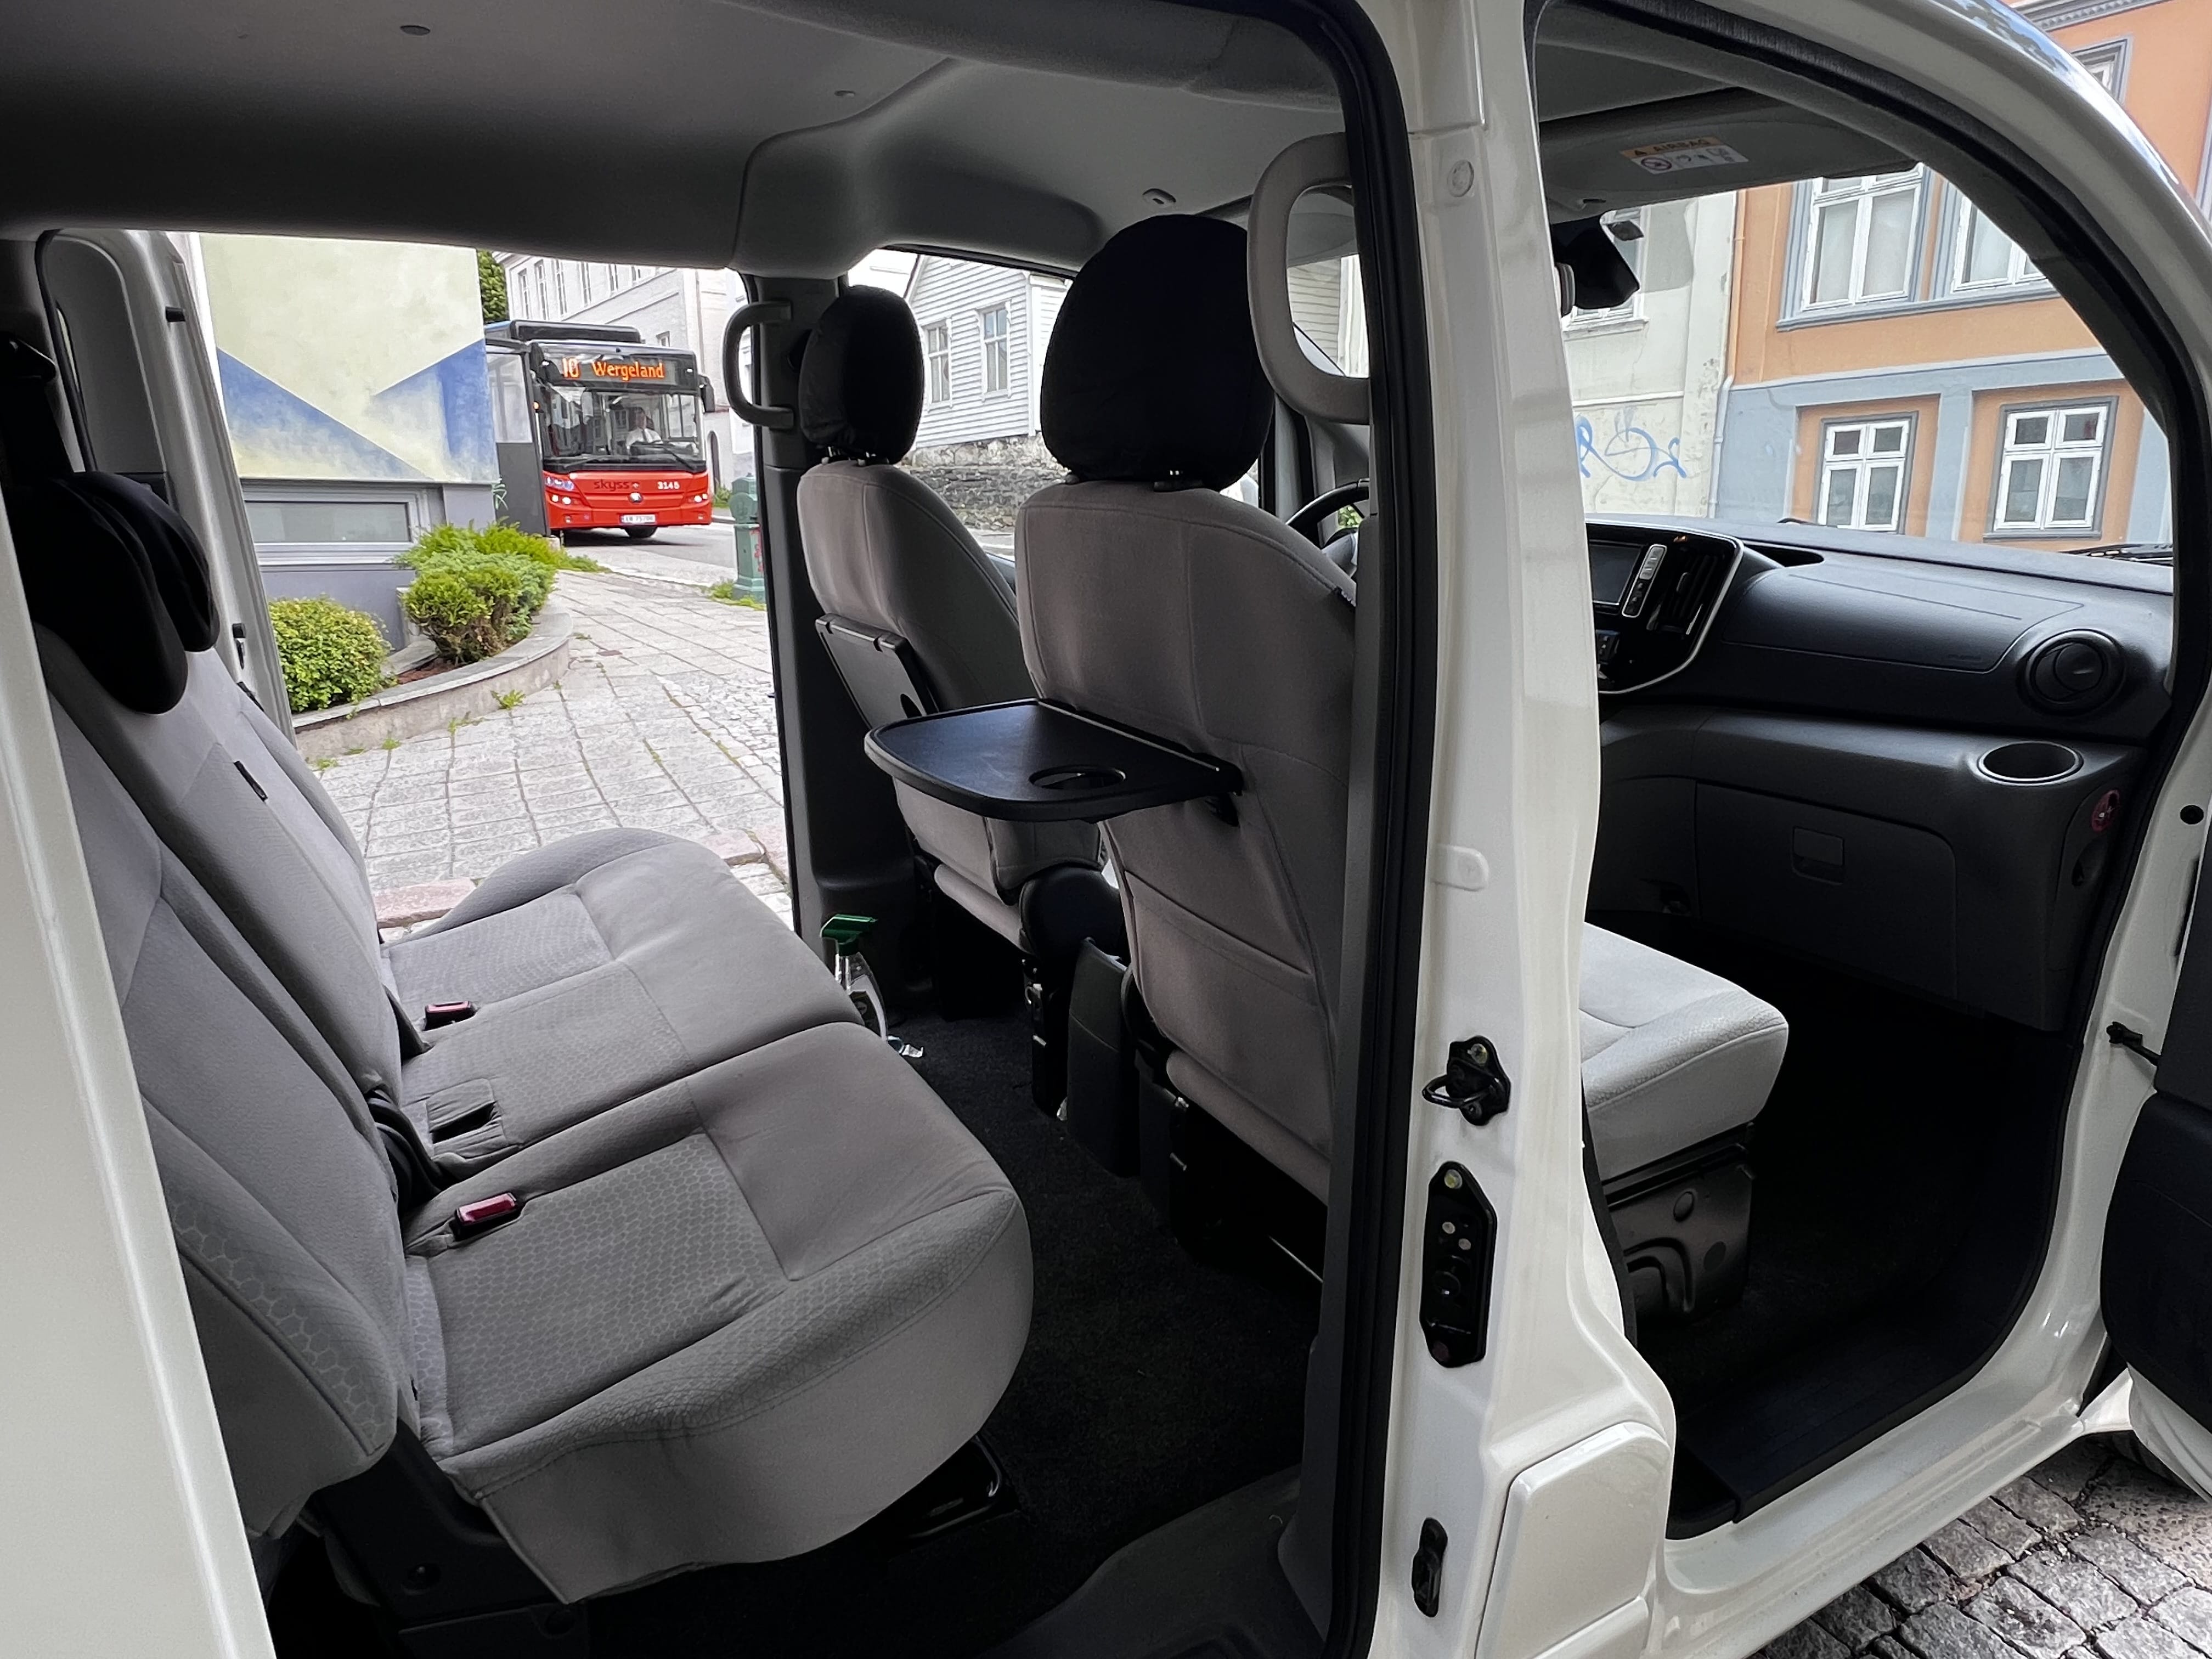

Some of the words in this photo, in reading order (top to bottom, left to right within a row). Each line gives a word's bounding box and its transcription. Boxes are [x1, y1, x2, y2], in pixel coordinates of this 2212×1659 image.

[562, 358, 580, 379] 10
[592, 359, 665, 381] Wergeland
[594, 479, 630, 491] skyss
